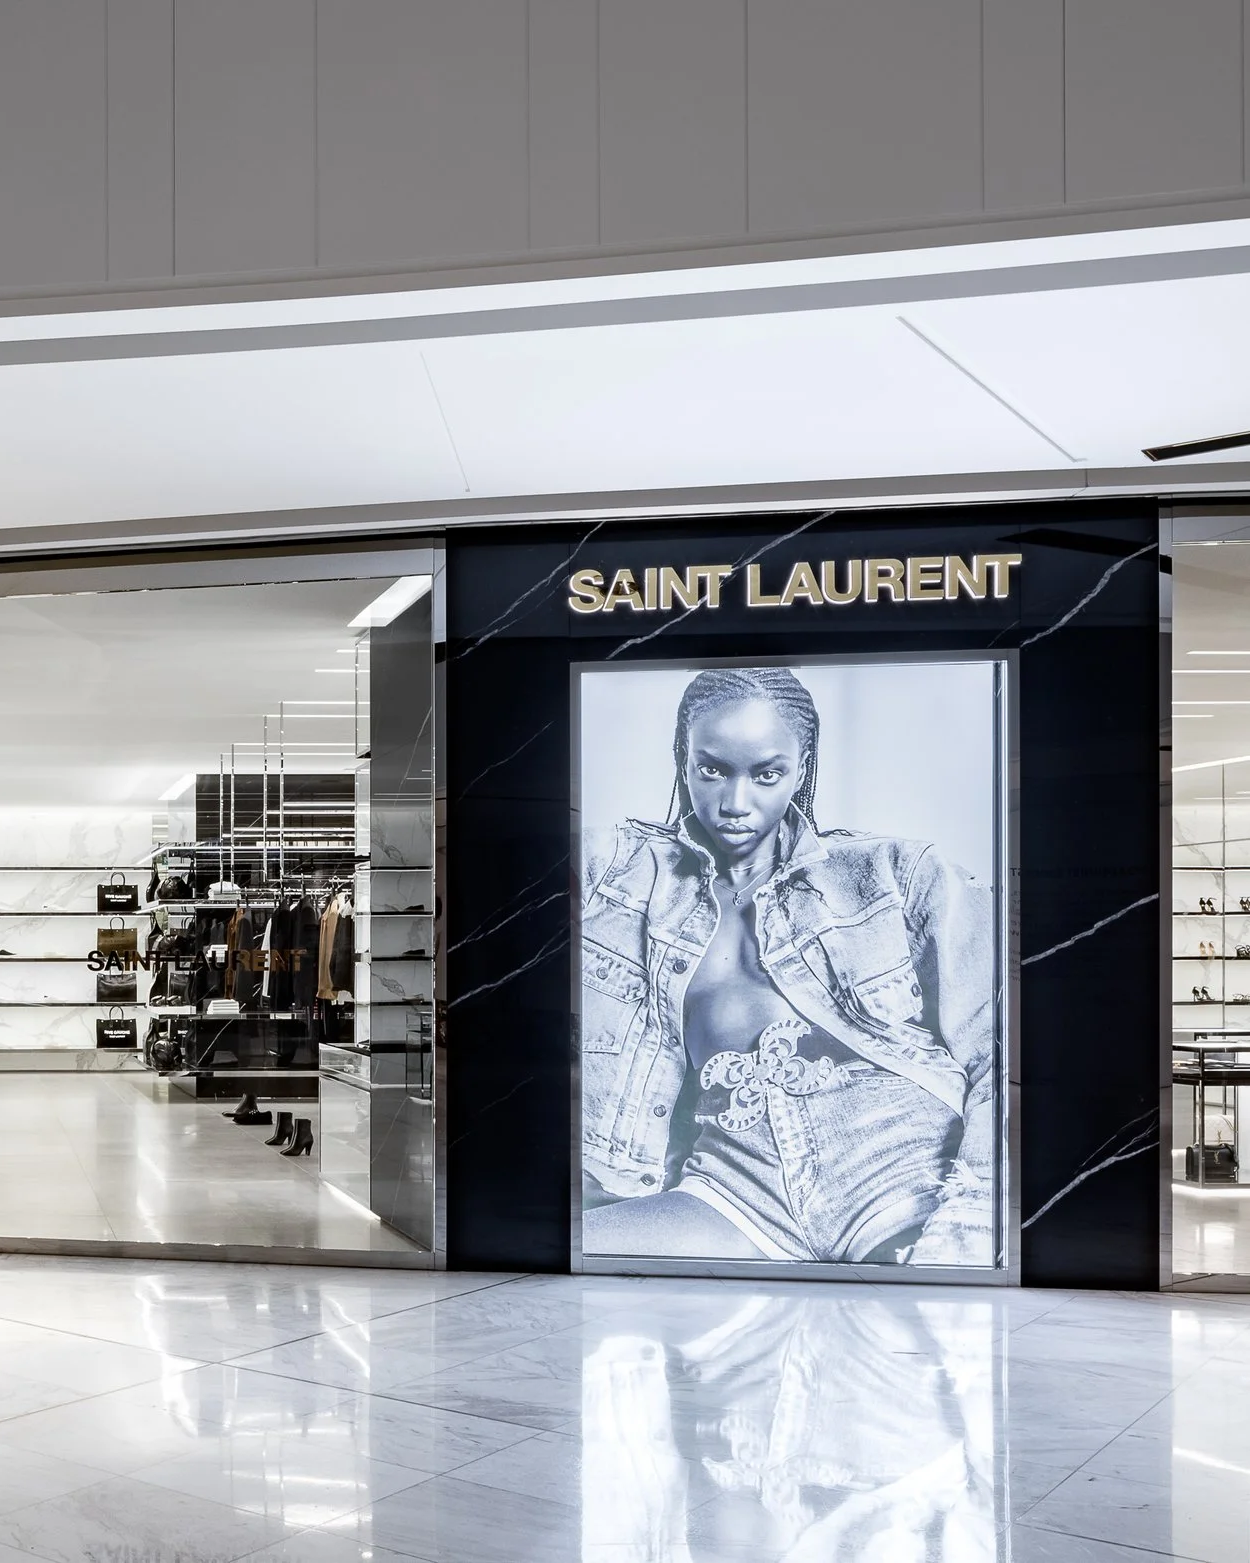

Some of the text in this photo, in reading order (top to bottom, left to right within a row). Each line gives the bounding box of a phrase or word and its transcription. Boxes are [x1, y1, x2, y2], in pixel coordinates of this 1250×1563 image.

[568, 553, 1022, 612] SAINT LAURENT
[87, 949, 308, 972] SAINT LAURENT
